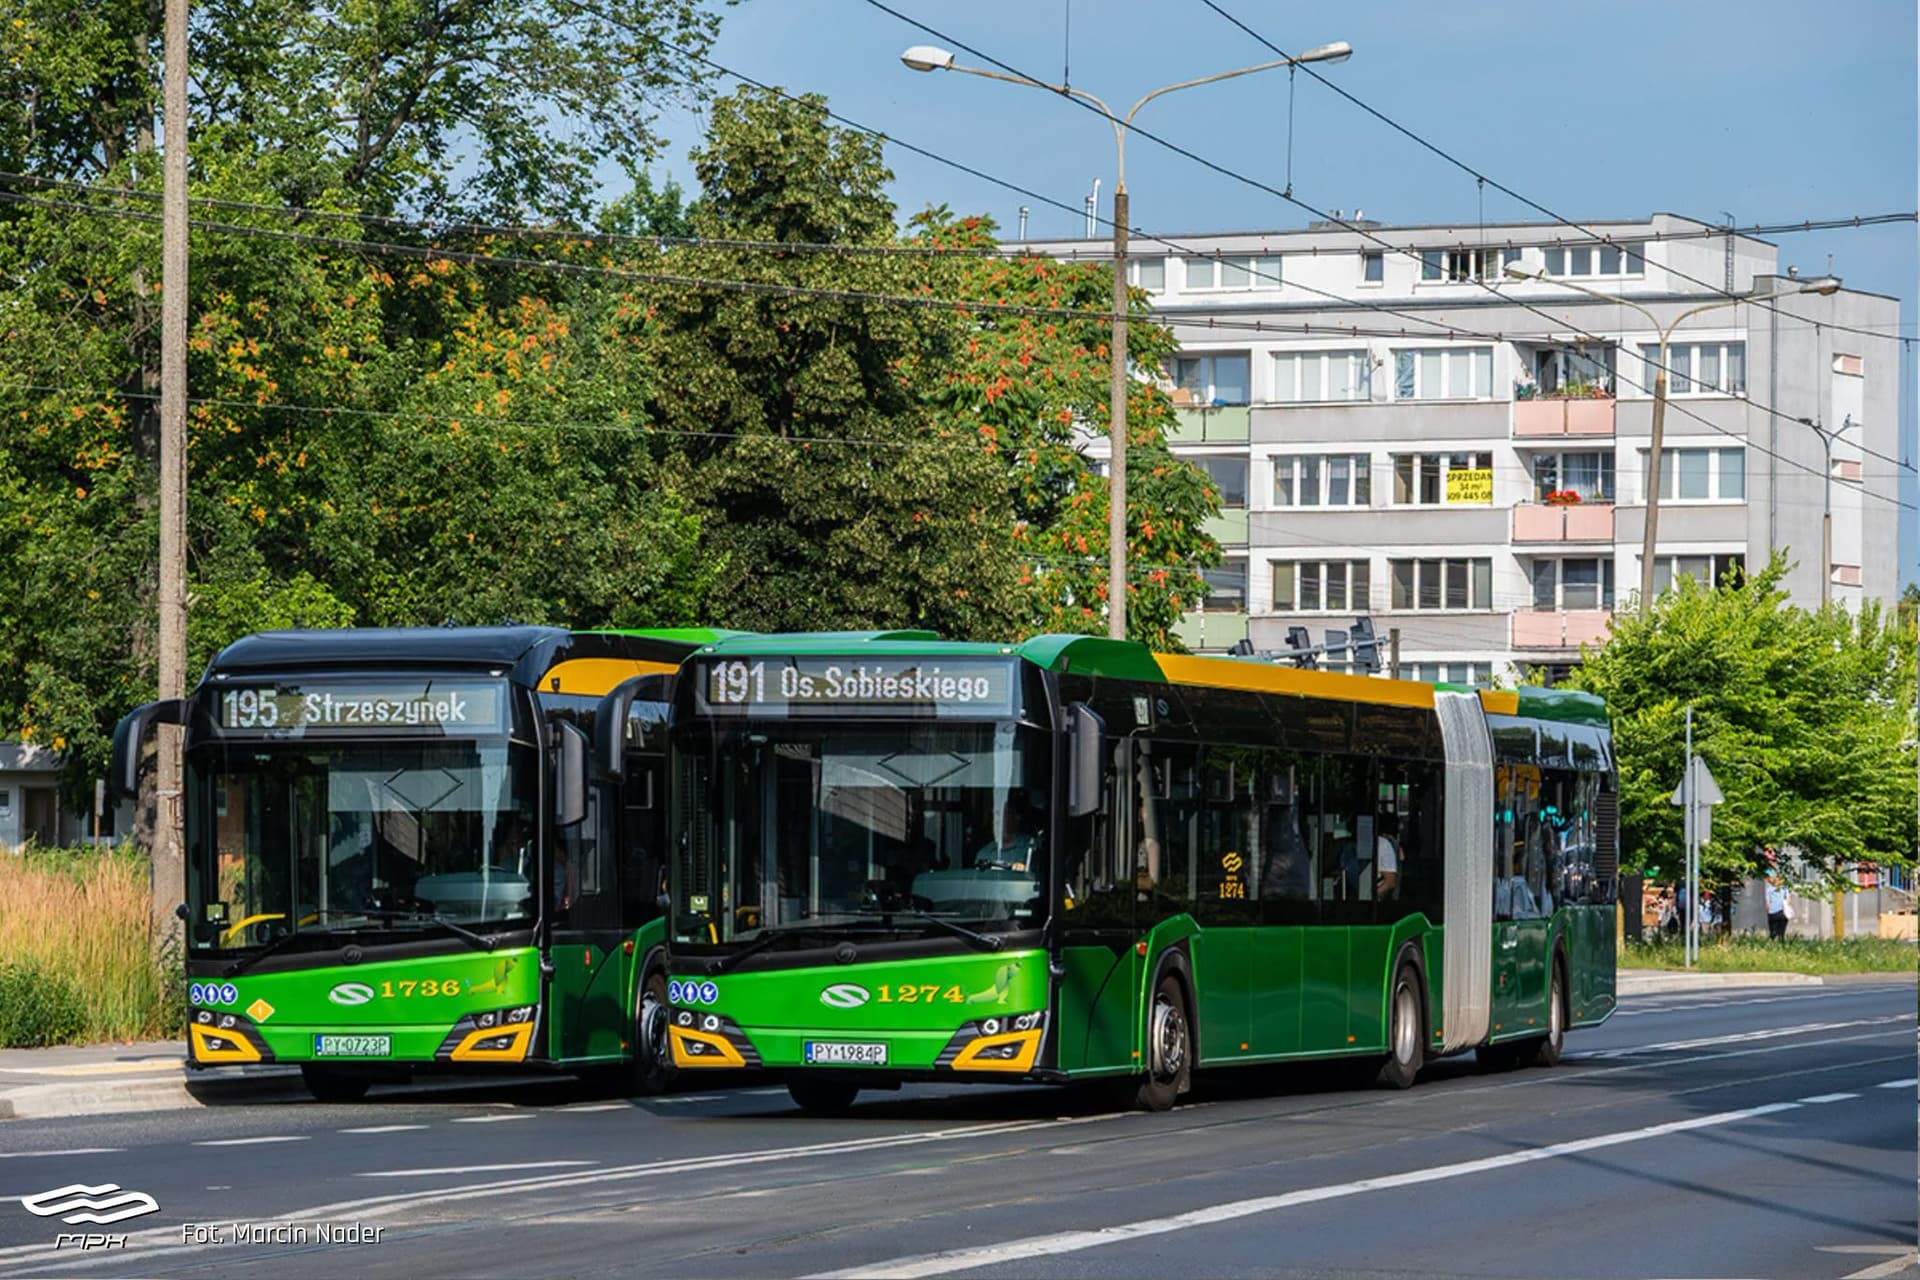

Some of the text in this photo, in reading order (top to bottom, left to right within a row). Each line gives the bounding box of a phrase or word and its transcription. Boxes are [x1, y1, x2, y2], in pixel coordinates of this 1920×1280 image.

[711, 661, 764, 703] 191
[825, 667, 989, 702] Sobieskiego
[223, 689, 467, 728] 195 Strzeszynek
[1220, 882, 1245, 899] 1274
[380, 979, 461, 998] 1736
[877, 984, 964, 1003] 1274
